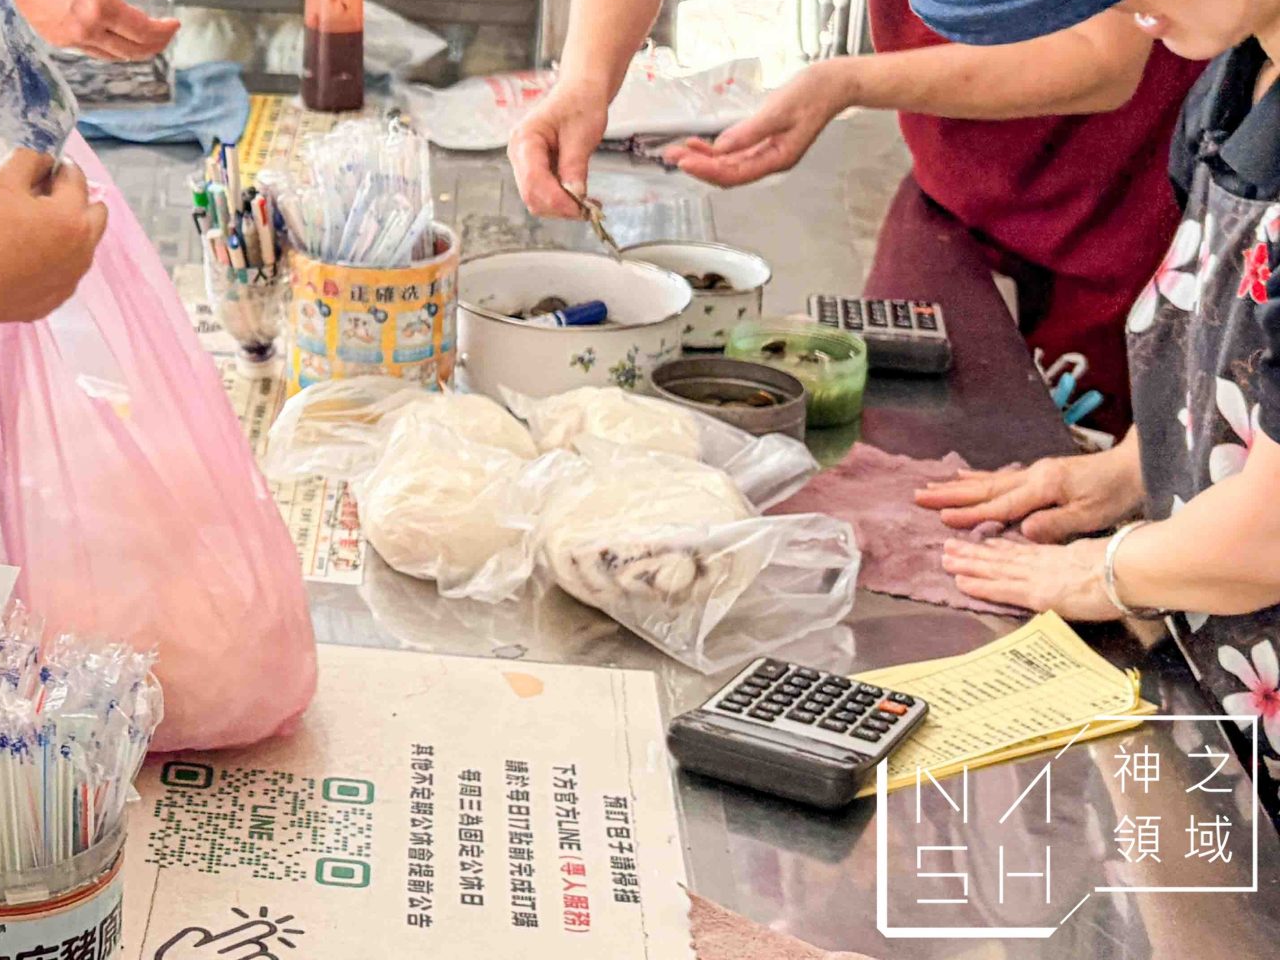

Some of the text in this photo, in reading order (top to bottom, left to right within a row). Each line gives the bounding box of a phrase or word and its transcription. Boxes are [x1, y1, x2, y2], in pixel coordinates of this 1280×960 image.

[247, 804, 276, 842] LINE
[407, 743, 434, 928] 其他不定期公休會提前公告
[458, 768, 484, 906] 每周三為固定公休日
[504, 759, 539, 928] 請於每日17點前完成訂購
[602, 794, 640, 904] 預訂包子請掃描
